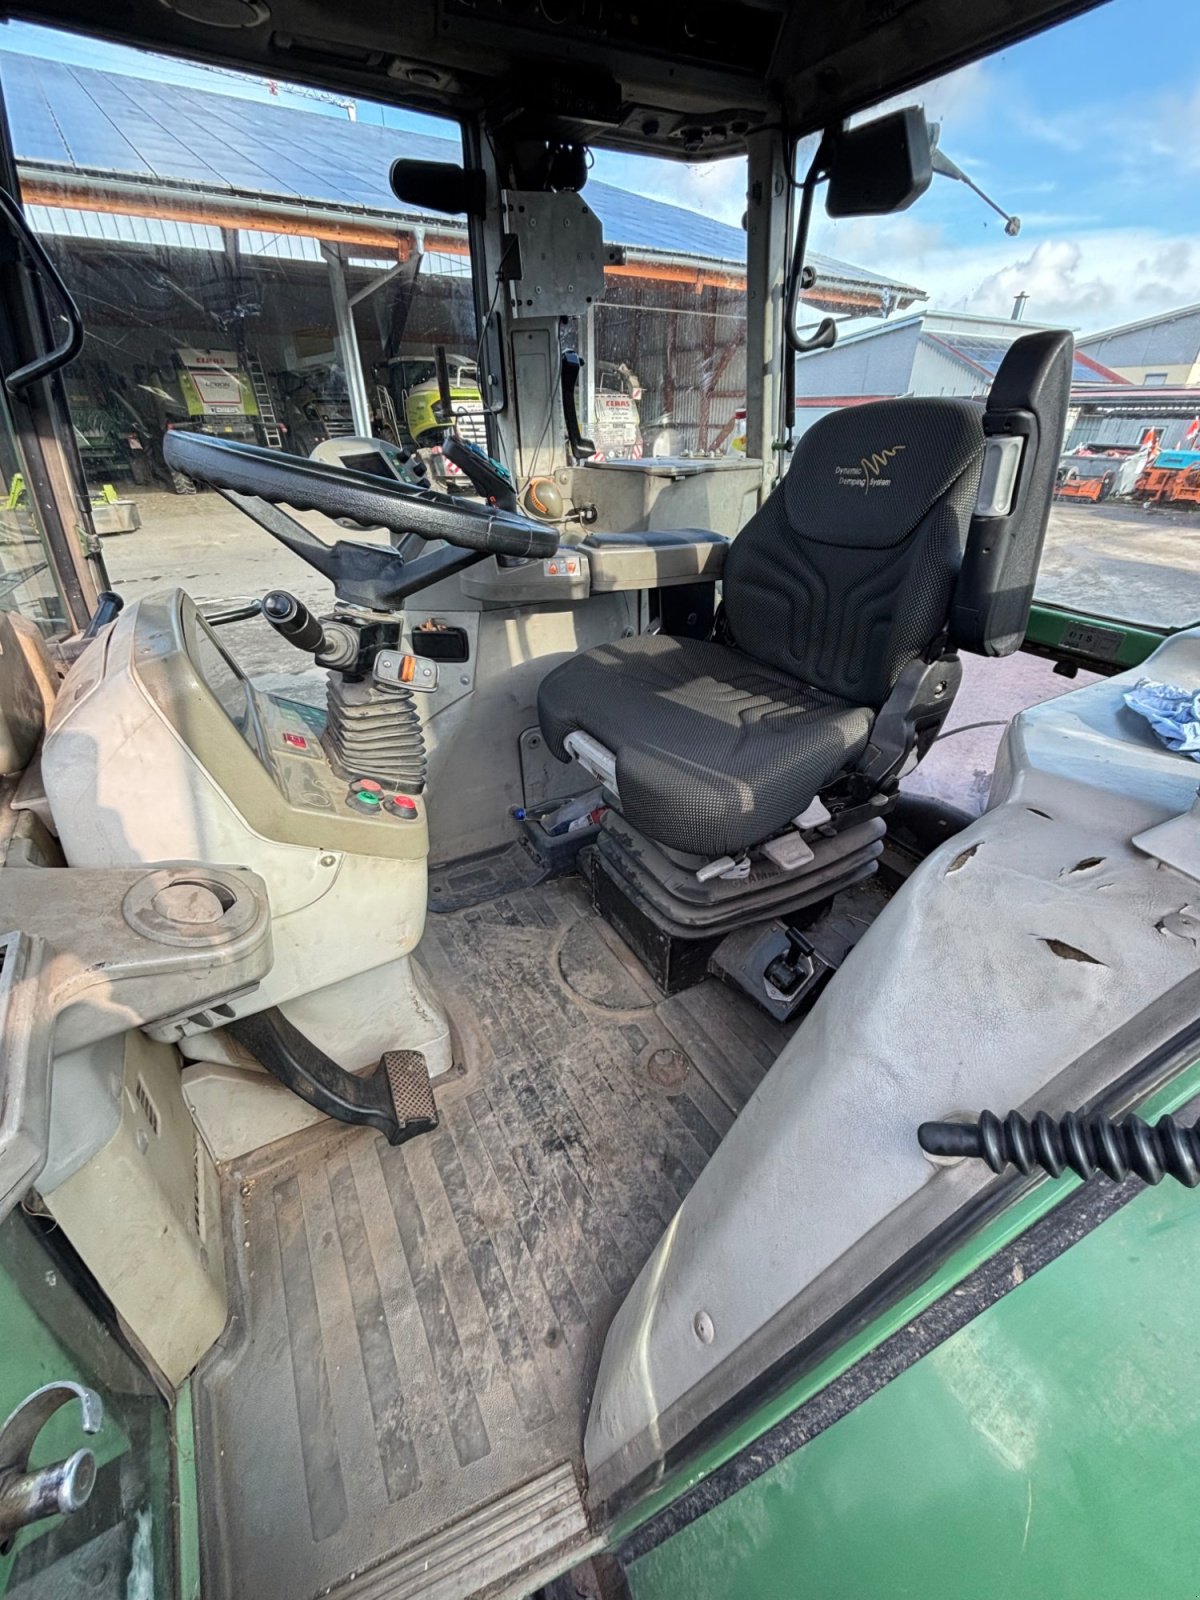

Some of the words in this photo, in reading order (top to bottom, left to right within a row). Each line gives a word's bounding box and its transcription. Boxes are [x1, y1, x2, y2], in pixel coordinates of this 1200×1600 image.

[835, 466, 862, 475] Dynamic
[839, 477, 866, 487] Damping
[869, 477, 891, 487] System
